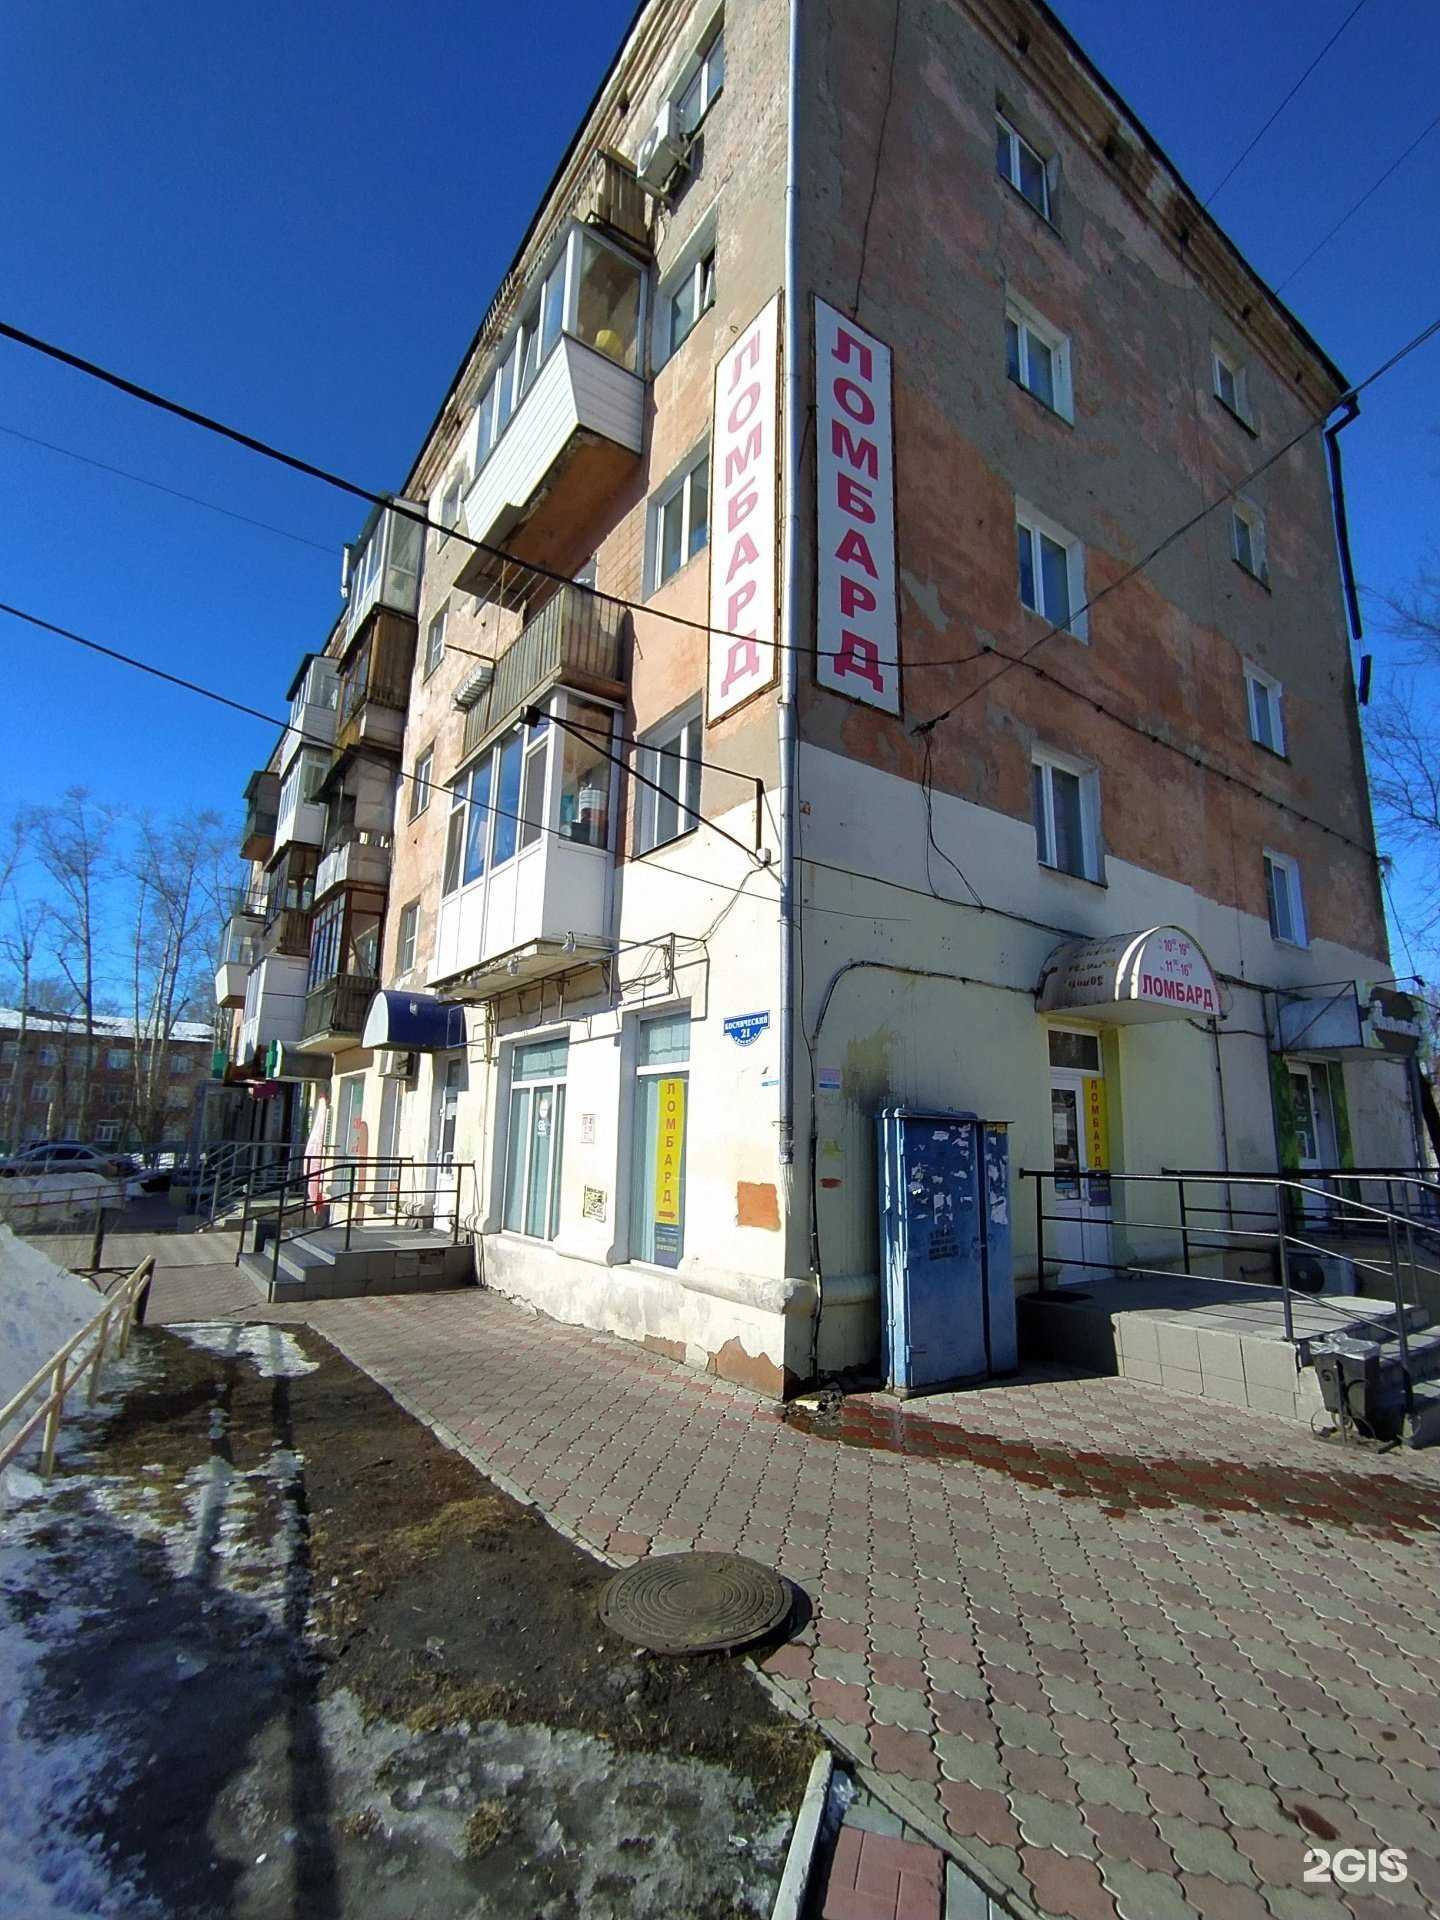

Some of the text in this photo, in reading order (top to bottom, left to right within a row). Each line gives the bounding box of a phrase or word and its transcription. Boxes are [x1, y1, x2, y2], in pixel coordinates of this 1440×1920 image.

[721, 330, 763, 699] ЛОМБАРД
[831, 327, 884, 693] ЛОМБАРД
[740, 1028, 751, 1039] 21
[1142, 974, 1214, 1011] ЛОМБАРД
[662, 1083, 676, 1205] ЛОМБАРД
[1090, 1079, 1102, 1168] ЛОМБАРД
